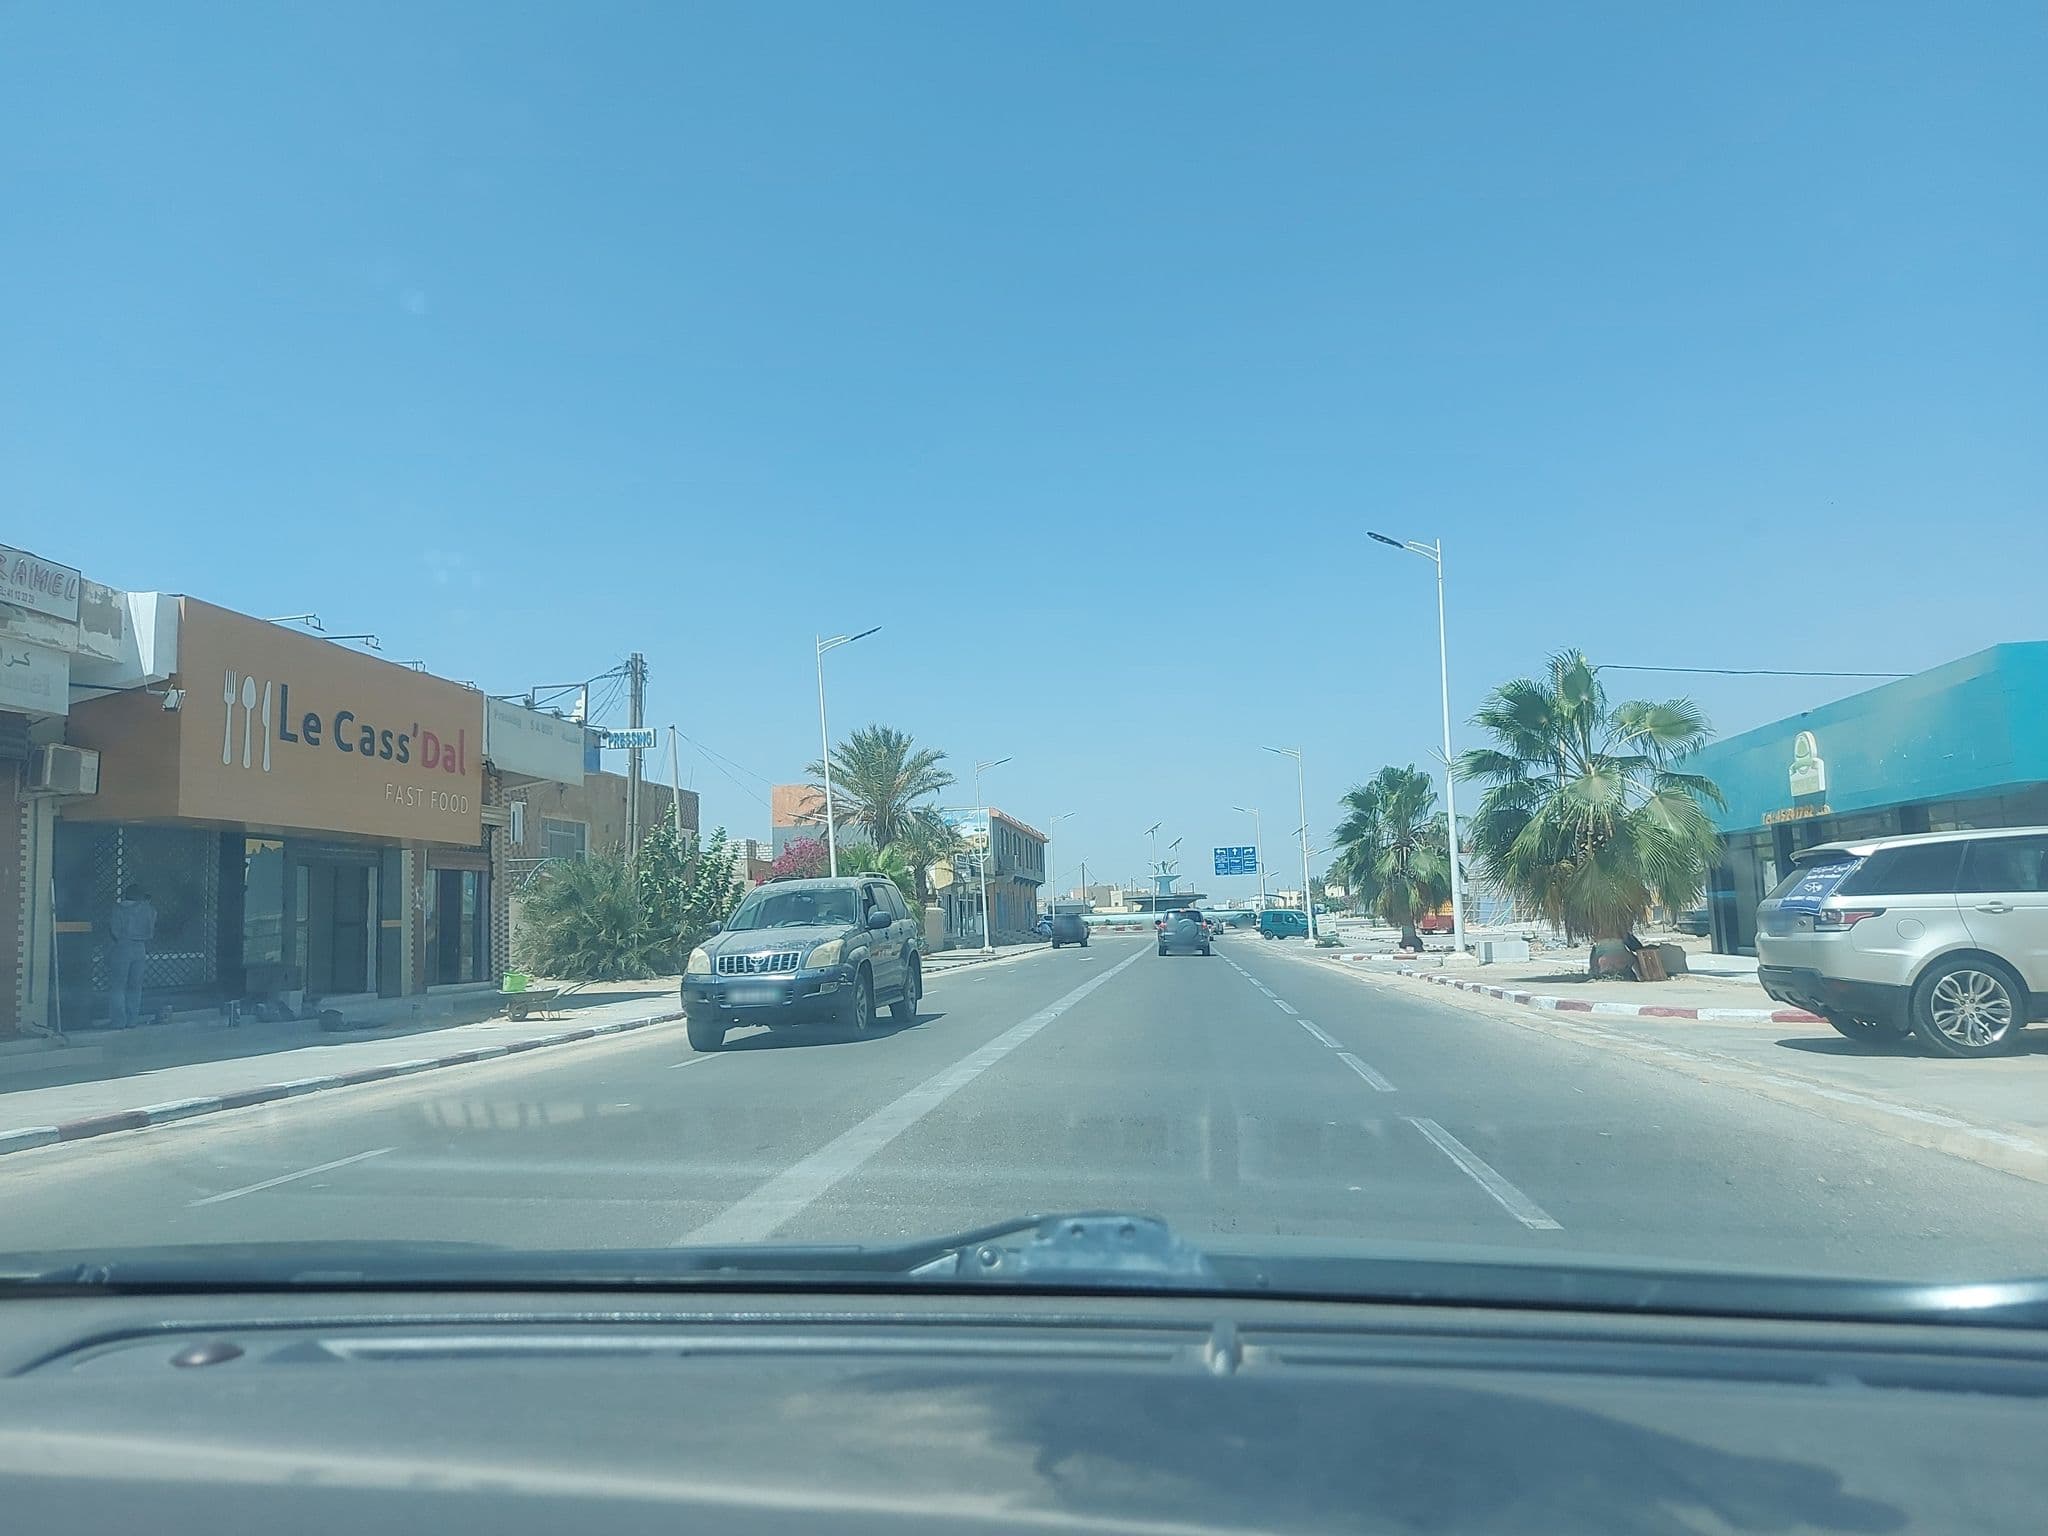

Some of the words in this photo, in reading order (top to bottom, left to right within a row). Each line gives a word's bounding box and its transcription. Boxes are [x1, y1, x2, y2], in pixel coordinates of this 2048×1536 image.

[279, 683, 322, 746] Le
[333, 710, 466, 776] Cass'Dal
[608, 731, 652, 749] PRESSING
[384, 783, 423, 808] FAST
[430, 790, 470, 815] FOOD
